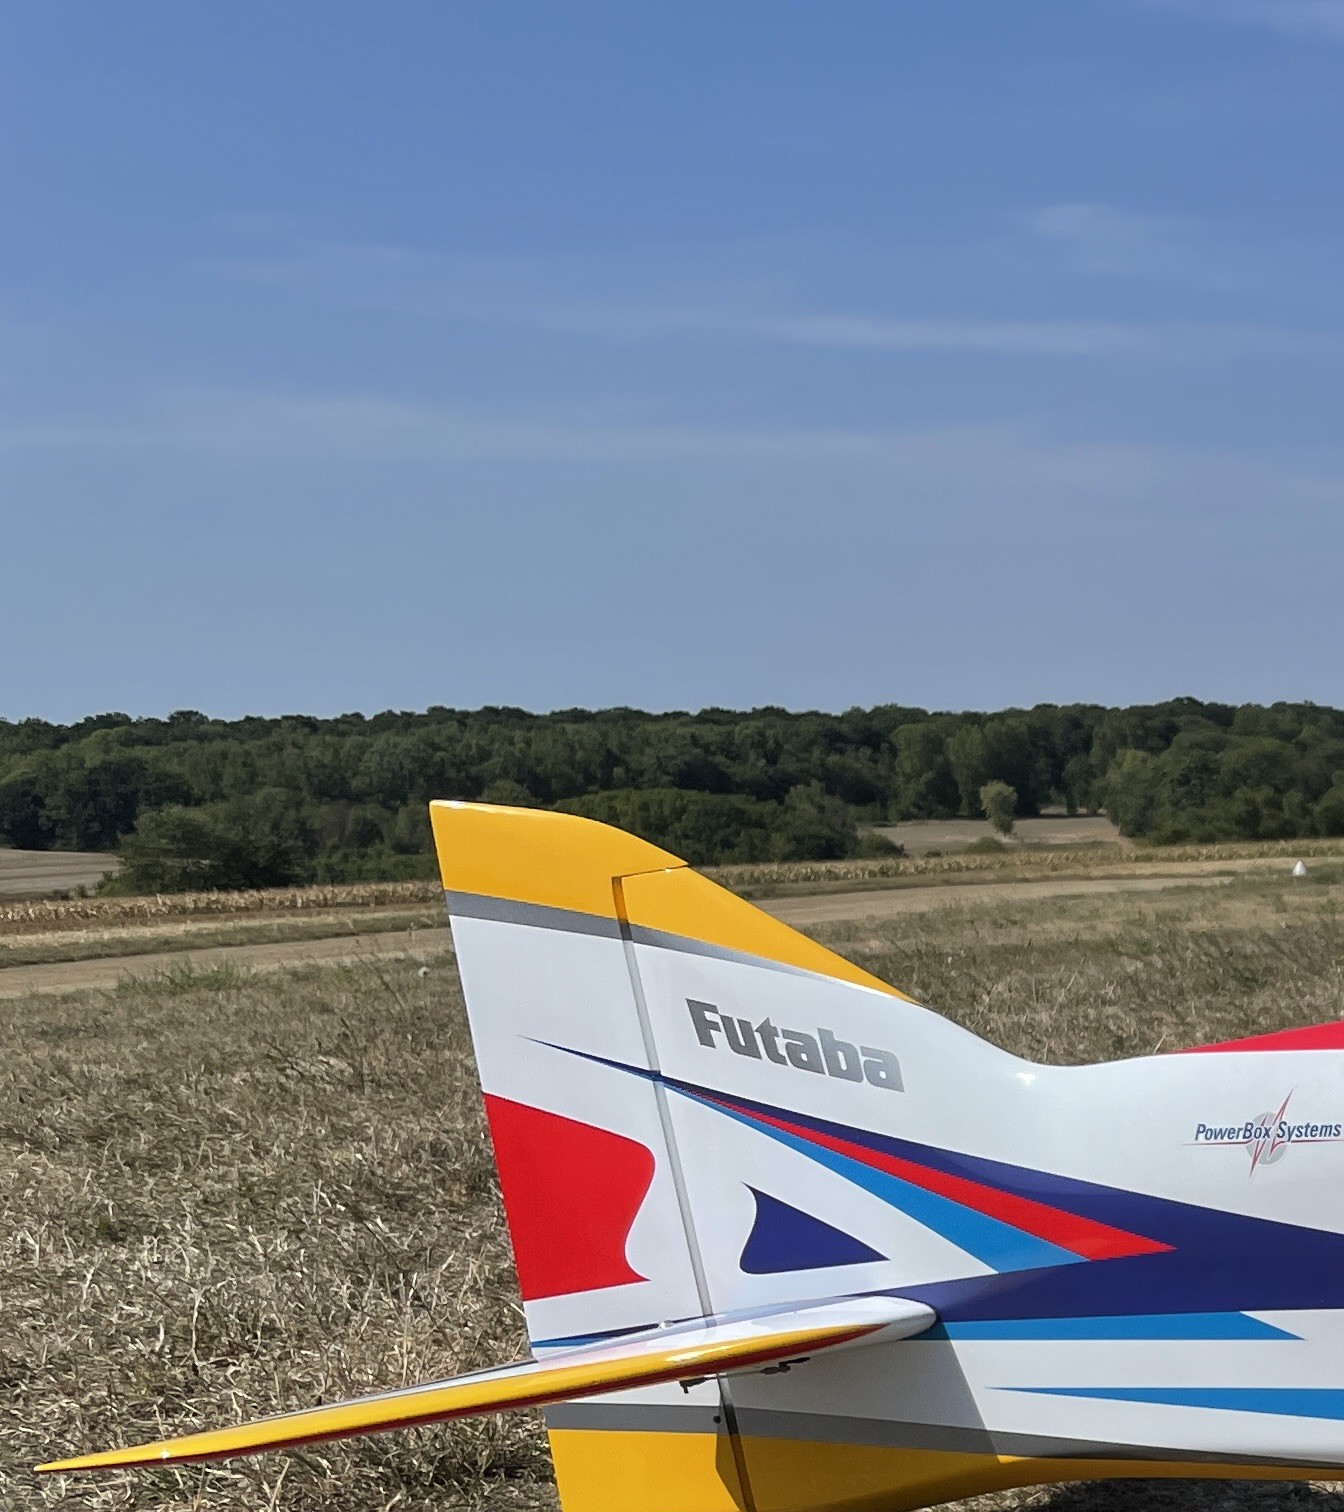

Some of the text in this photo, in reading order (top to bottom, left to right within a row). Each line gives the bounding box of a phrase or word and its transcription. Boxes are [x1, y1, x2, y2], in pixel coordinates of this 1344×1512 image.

[685, 997, 905, 1093] Futaba
[1194, 1120, 1342, 1143] PowerBox Systems
